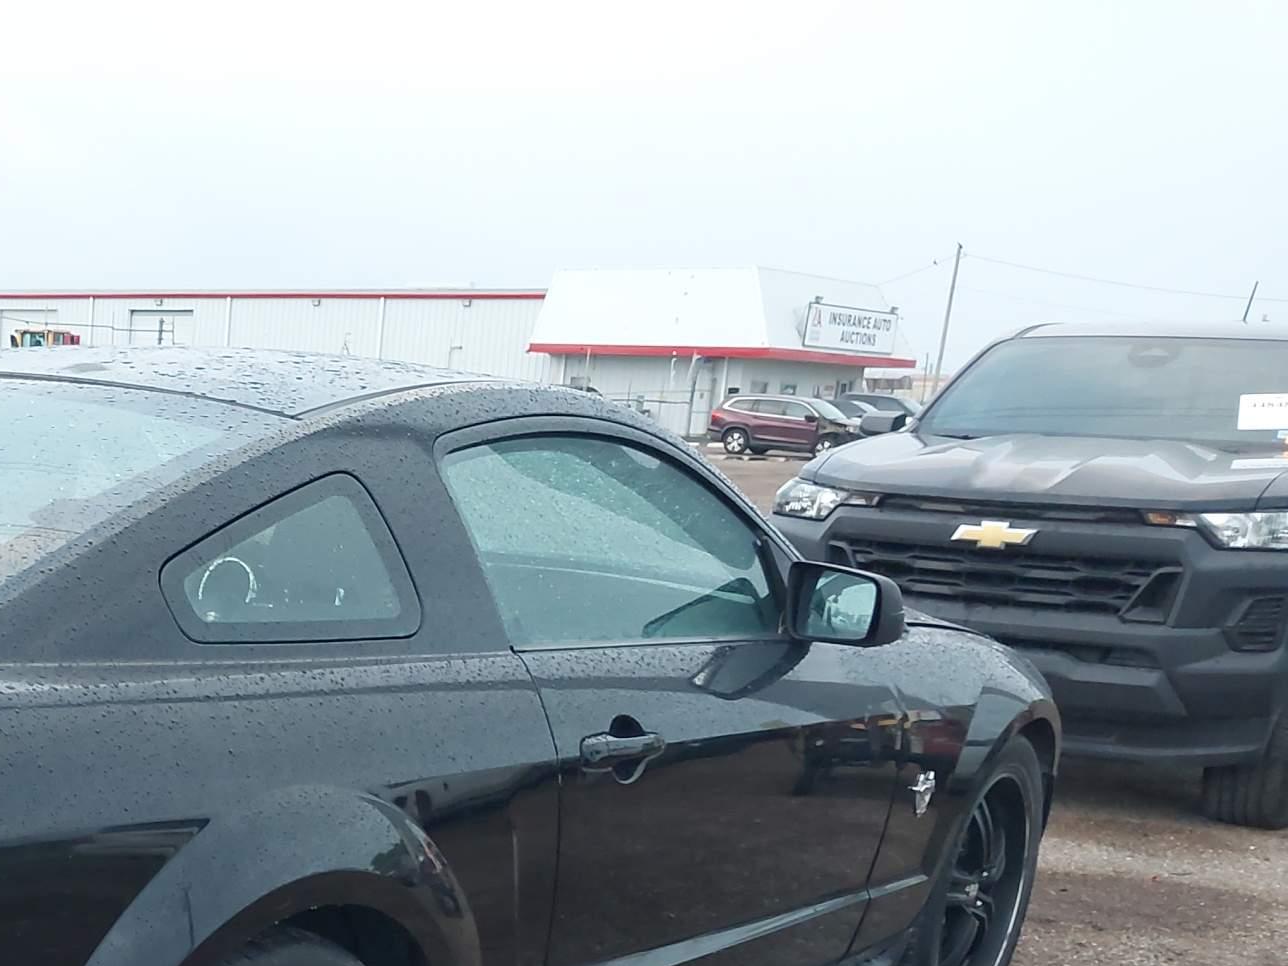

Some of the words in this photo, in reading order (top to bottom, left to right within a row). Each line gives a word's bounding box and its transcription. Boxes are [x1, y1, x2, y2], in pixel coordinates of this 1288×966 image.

[829, 312, 872, 329] INSURANCE
[872, 318, 891, 331] AUTO
[840, 330, 876, 346] AUCTIONS
